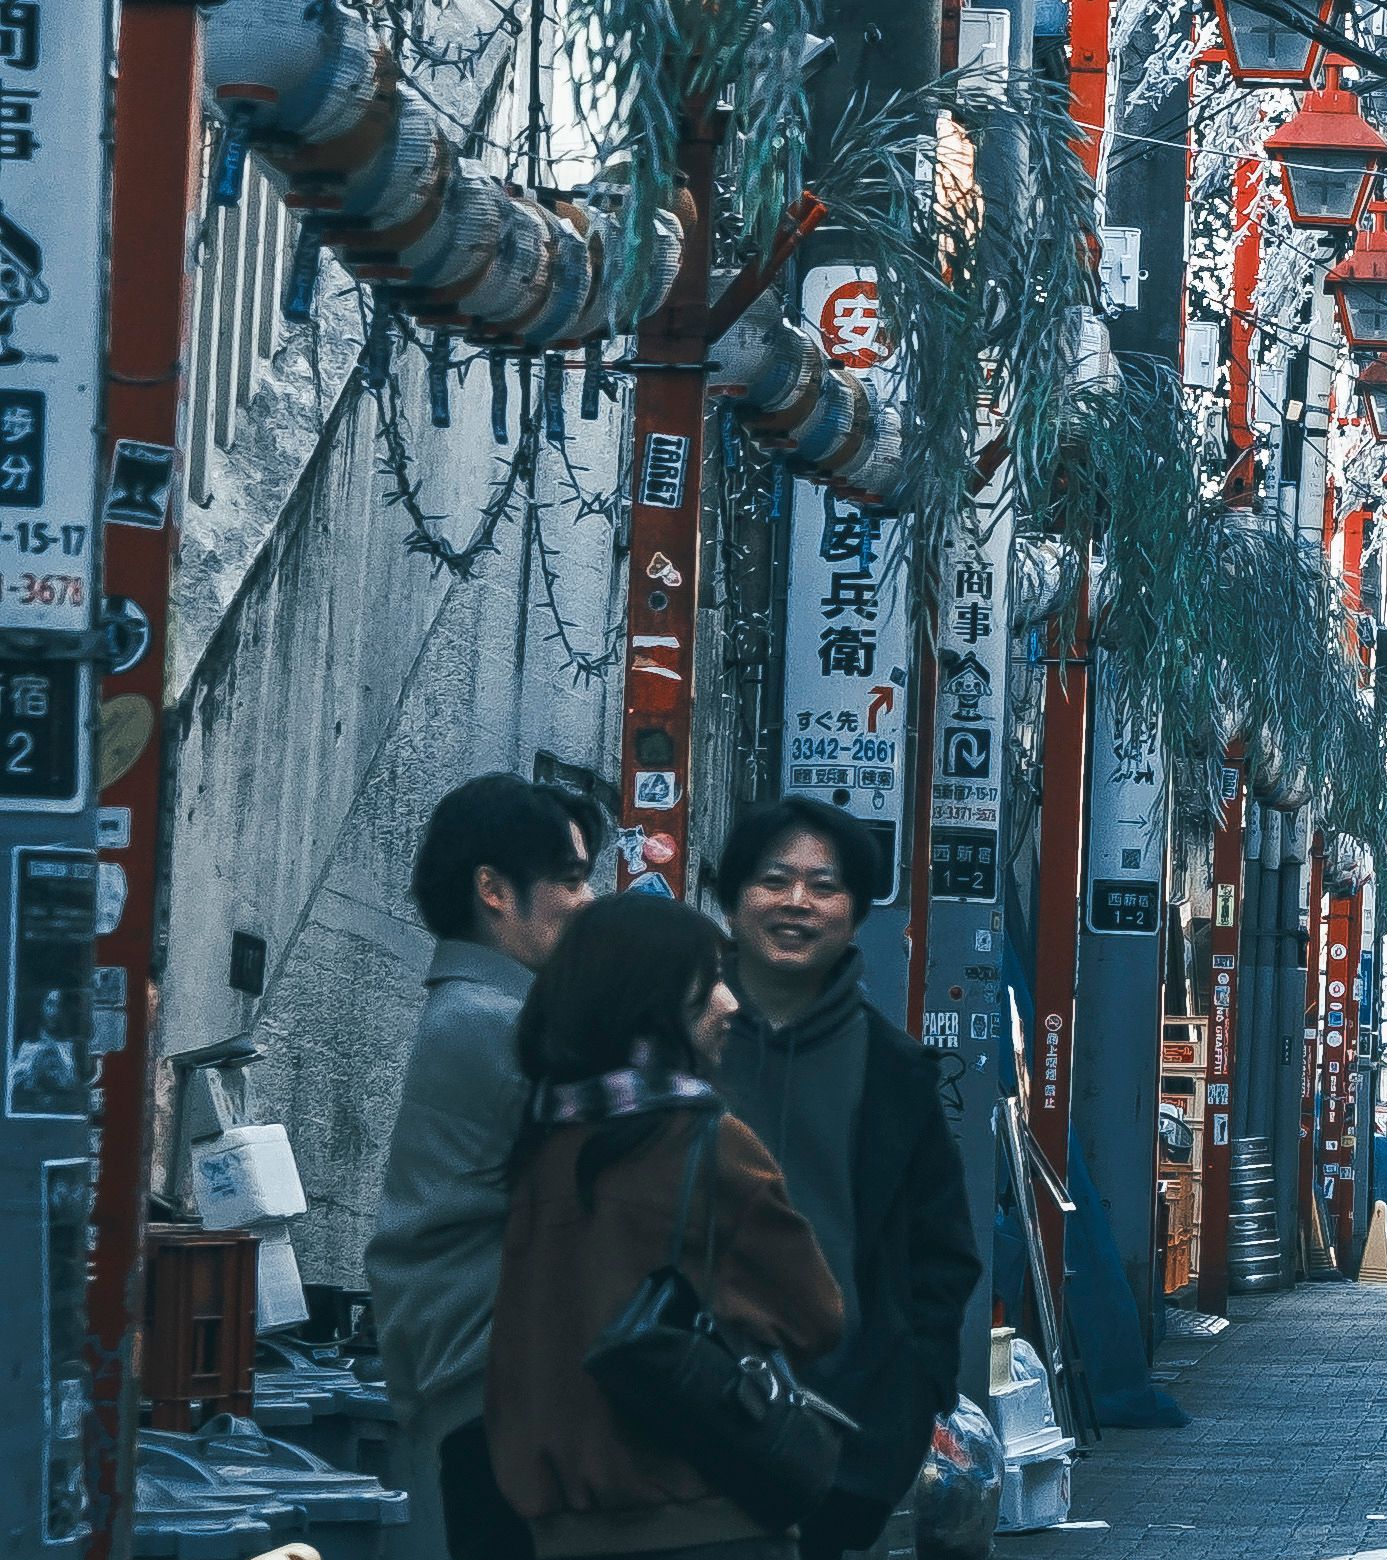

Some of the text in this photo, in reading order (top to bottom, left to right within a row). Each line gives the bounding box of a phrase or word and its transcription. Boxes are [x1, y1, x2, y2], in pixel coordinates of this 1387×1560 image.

[832, 292, 889, 356] 安
[0, 523, 86, 556] -15-17
[0, 574, 85, 607] -3678
[954, 559, 995, 645] 商事
[796, 710, 860, 733] すぐ先
[791, 737, 896, 763] 3342-2661
